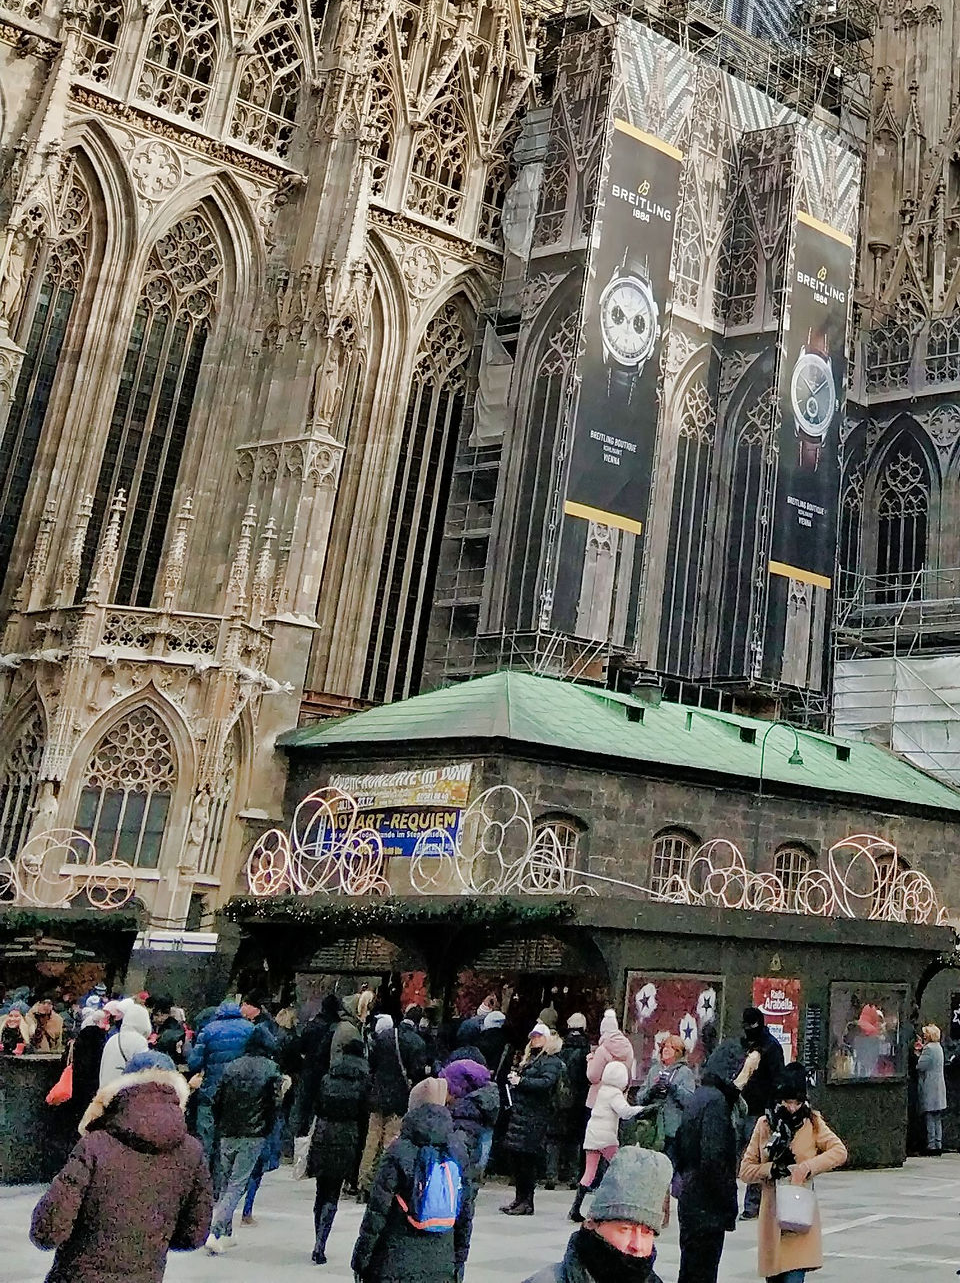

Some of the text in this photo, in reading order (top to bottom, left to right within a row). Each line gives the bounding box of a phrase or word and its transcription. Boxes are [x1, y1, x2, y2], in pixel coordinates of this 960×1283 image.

[611, 184, 672, 222] BREITLING
[632, 208, 650, 223] 1884
[796, 271, 845, 303] BREITLING
[813, 292, 828, 305] 1884
[590, 430, 637, 453] BREITLING BOUTIQUE
